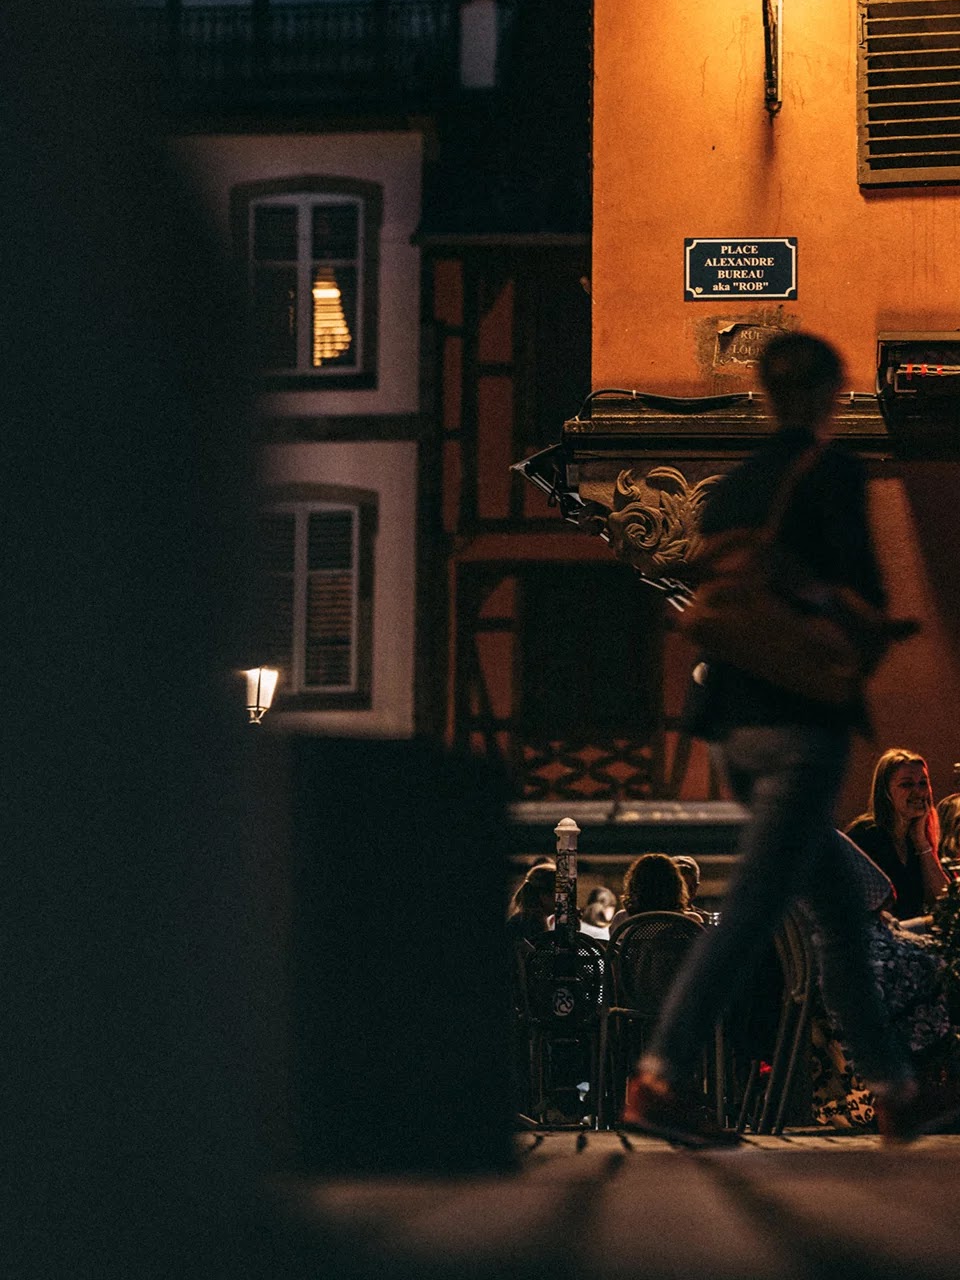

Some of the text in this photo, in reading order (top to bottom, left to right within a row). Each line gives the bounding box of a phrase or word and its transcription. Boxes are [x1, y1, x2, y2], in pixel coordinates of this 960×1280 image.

[721, 245, 758, 254] PLACE
[704, 257, 774, 266] ALEXANDRE
[717, 269, 764, 279] BUREAU
[712, 282, 769, 291] aka "ROB"
